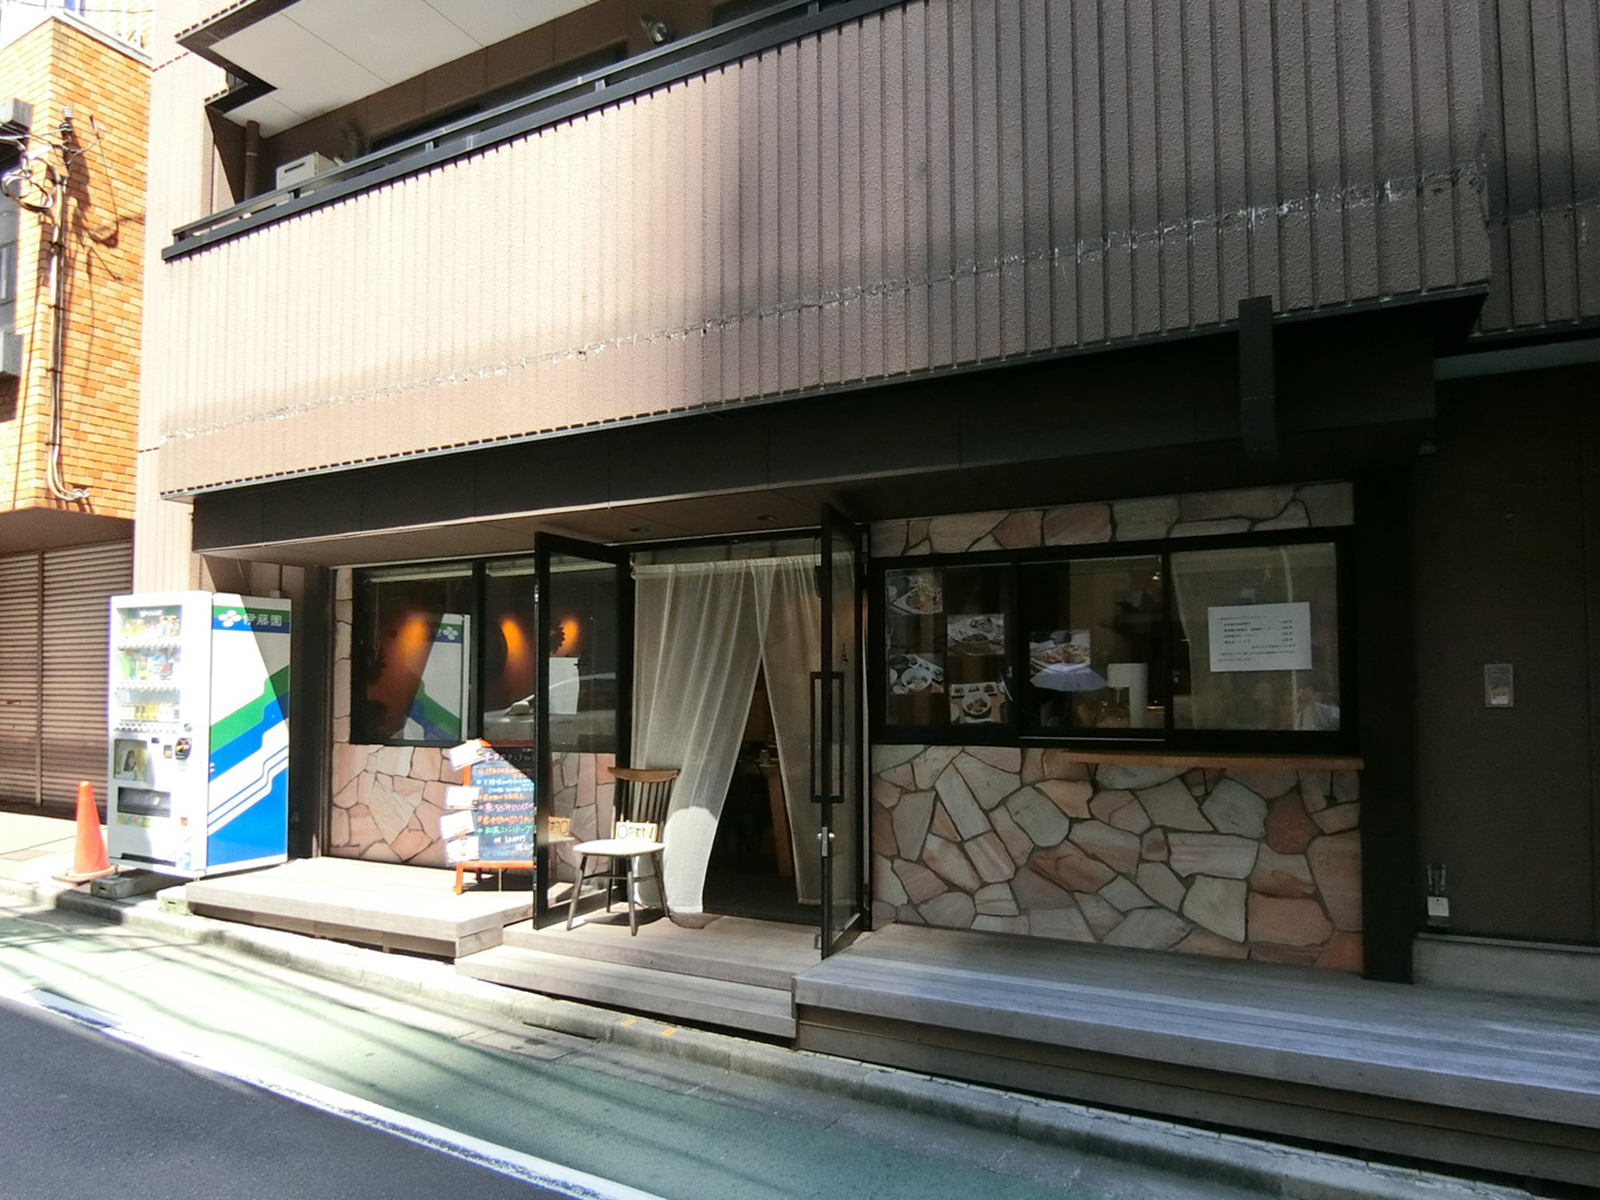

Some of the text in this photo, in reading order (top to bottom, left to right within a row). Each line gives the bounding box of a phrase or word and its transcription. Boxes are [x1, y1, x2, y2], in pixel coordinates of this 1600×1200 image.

[243, 613, 282, 627] 伊藤園
[617, 824, 655, 839] OPEN
